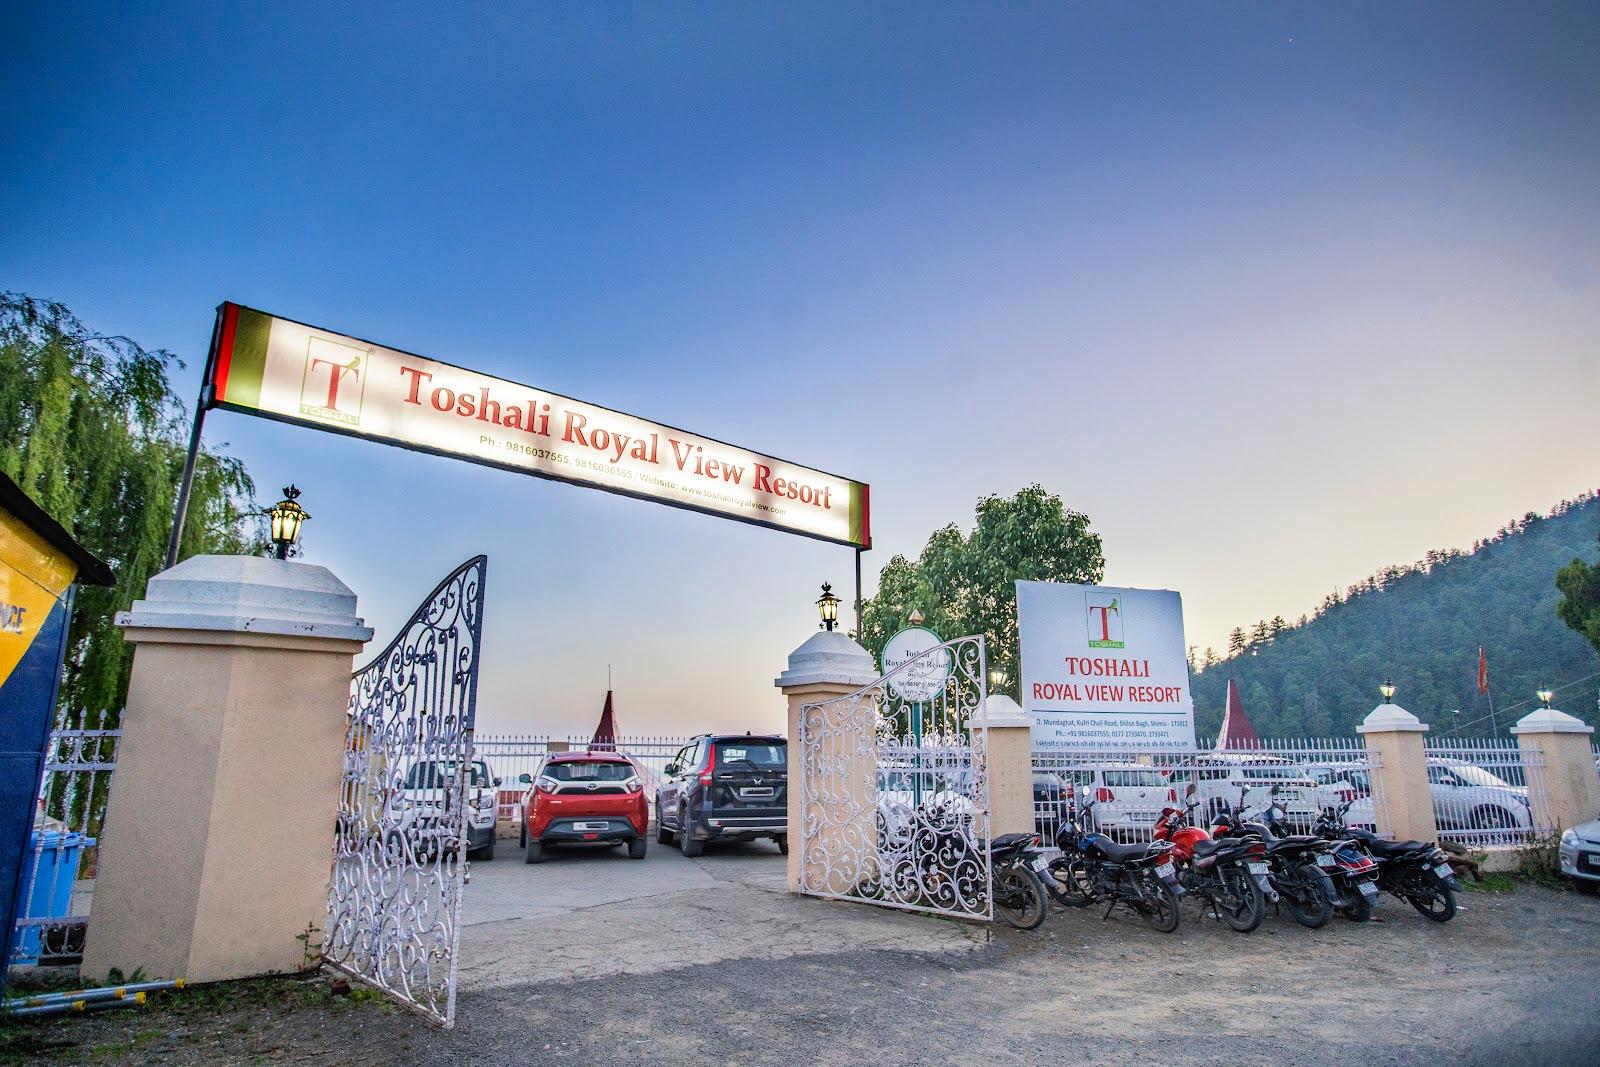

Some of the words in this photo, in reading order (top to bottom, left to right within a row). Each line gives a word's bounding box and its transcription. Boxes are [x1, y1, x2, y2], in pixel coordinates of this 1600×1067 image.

[400, 366, 551, 437] Toshali
[561, 410, 659, 465] Royal
[669, 438, 745, 486] View
[752, 463, 832, 510] Resort
[506, 441, 573, 465] 9816037555,
[575, 458, 633, 479] 9816036555
[1065, 657, 1150, 678] TOSHALI
[1033, 683, 1081, 701] ROYAL
[1085, 685, 1124, 702] VIEW
[1128, 687, 1181, 703] RESORT
